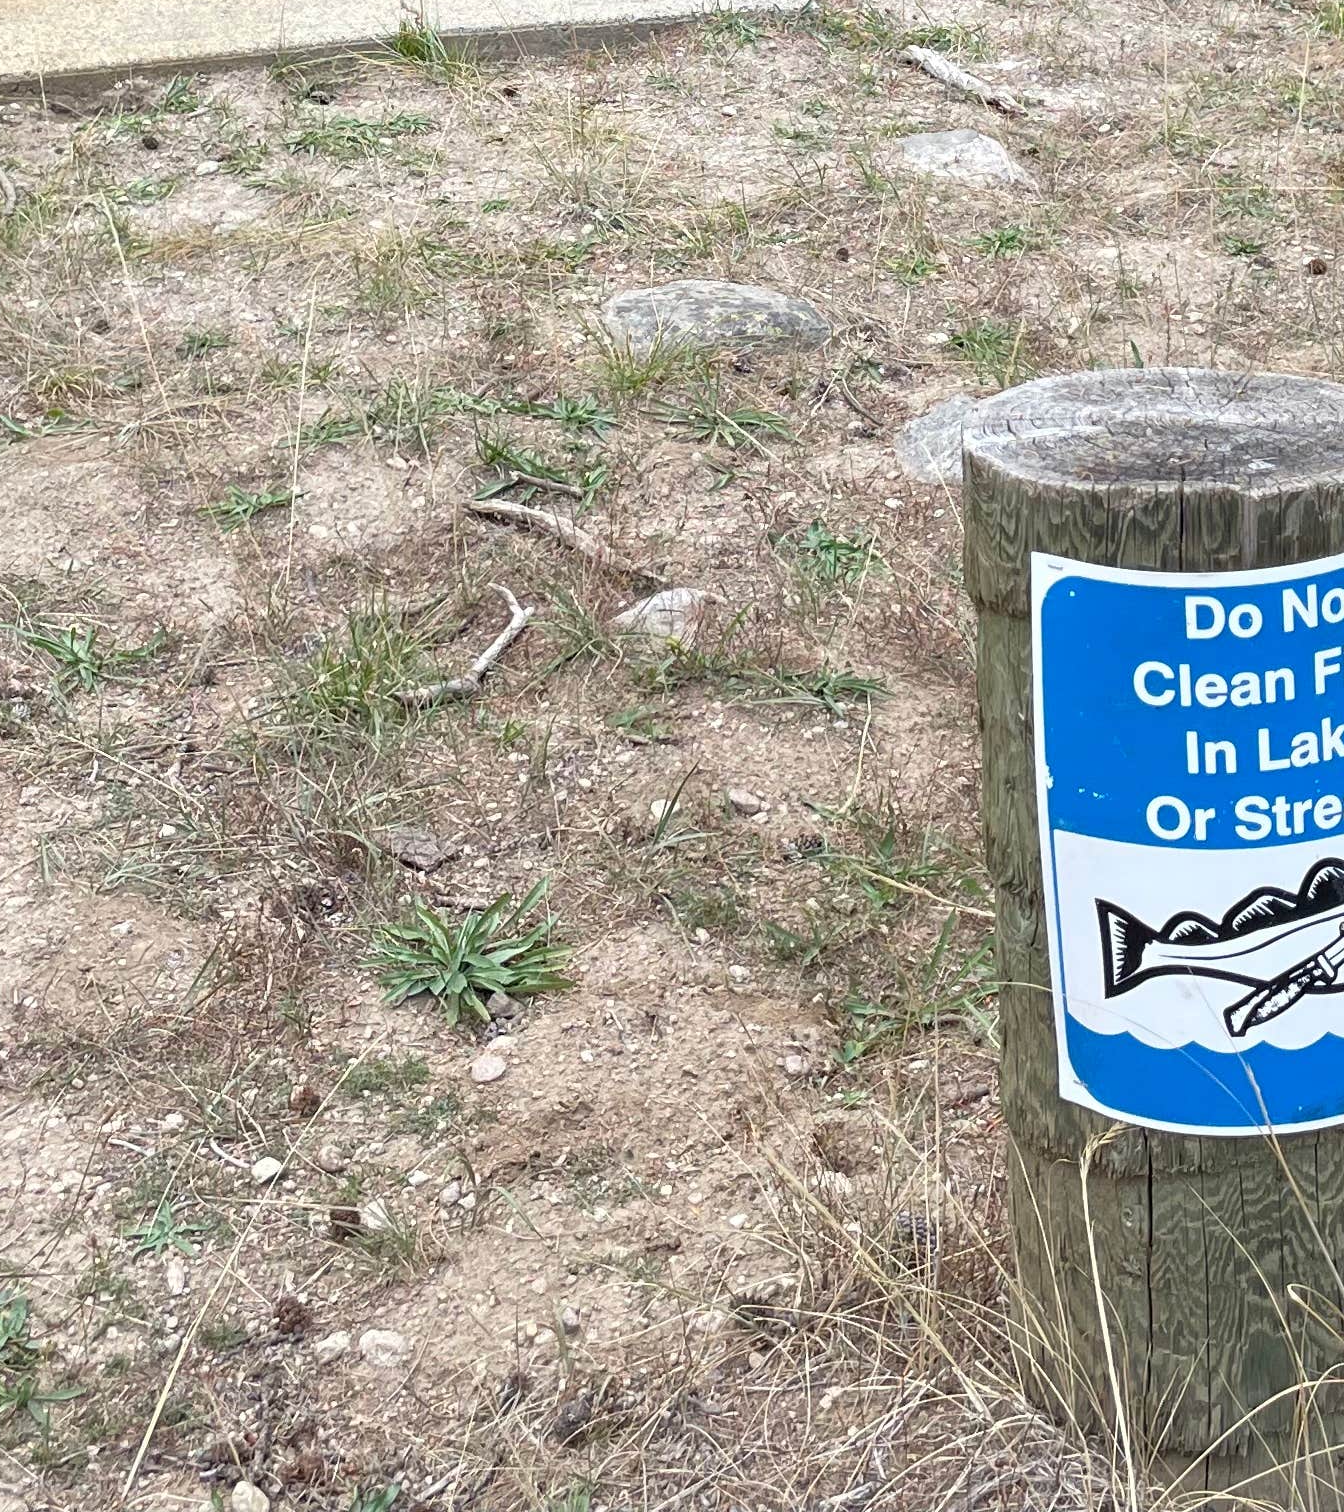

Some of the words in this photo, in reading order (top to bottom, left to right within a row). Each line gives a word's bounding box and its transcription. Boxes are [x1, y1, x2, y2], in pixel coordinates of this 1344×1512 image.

[1185, 596, 1263, 639] Do
[1133, 661, 1295, 708] Clean
[1186, 731, 1237, 774] In
[1146, 795, 1216, 841] Or
